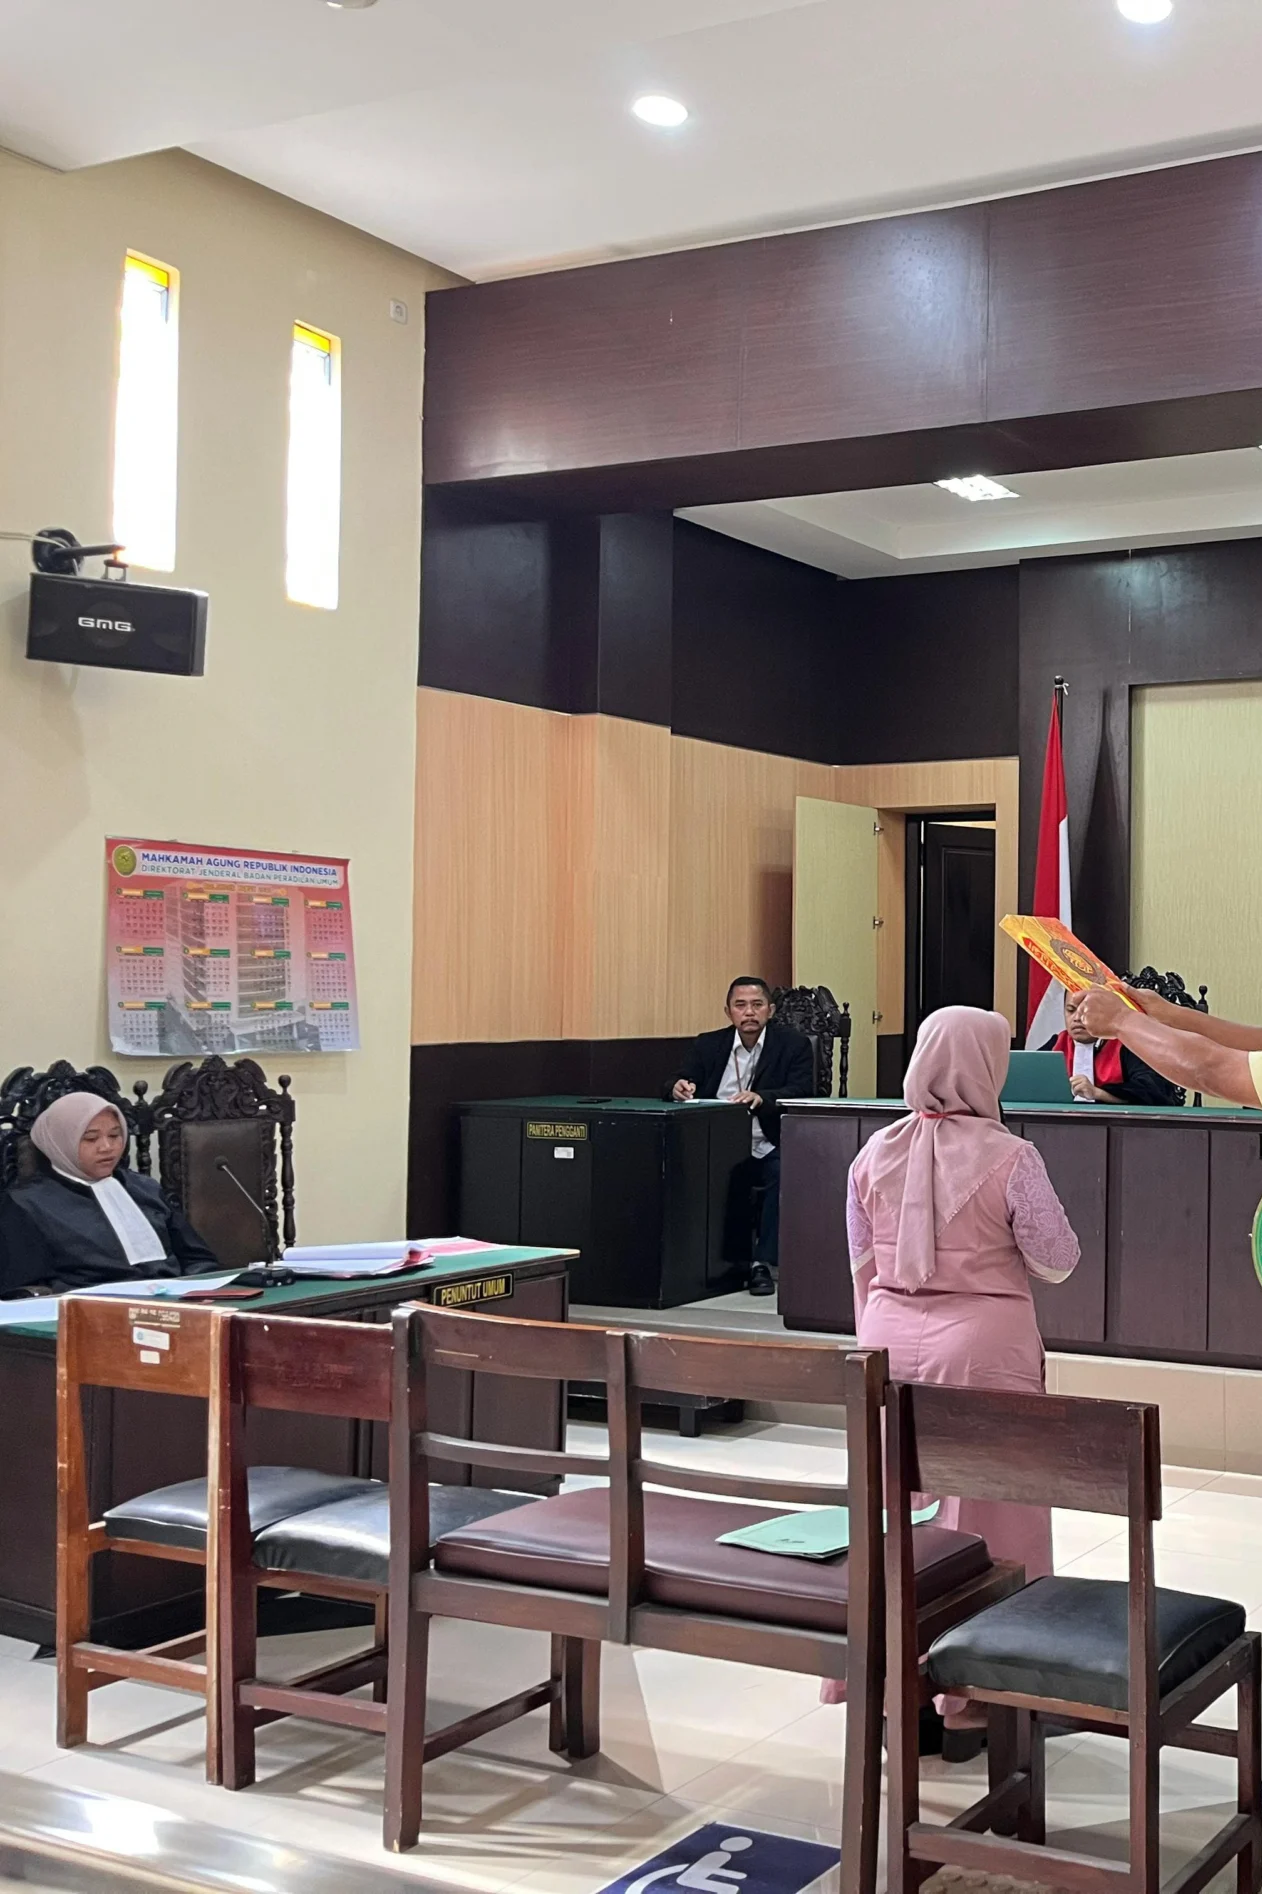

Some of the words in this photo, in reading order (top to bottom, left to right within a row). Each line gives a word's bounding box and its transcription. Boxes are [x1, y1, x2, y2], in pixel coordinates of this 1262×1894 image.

[77, 616, 133, 632] GMG
[141, 852, 203, 866] MAHKAMAH
[206, 858, 241, 869] AGUNG
[243, 860, 288, 873] REPUBLIK
[290, 865, 337, 877] INDONESIA
[141, 864, 195, 876] DIREKTORAT
[198, 868, 241, 879] JENDERAL
[243, 871, 272, 881] BADAN
[273, 874, 315, 884] PERADILAN
[316, 878, 338, 886] UMUM
[528, 1123, 555, 1137] PANITERA
[555, 1124, 586, 1138] PENGGANTI
[441, 1282, 482, 1306] PENUNTUT
[482, 1277, 506, 1298] UMUM
